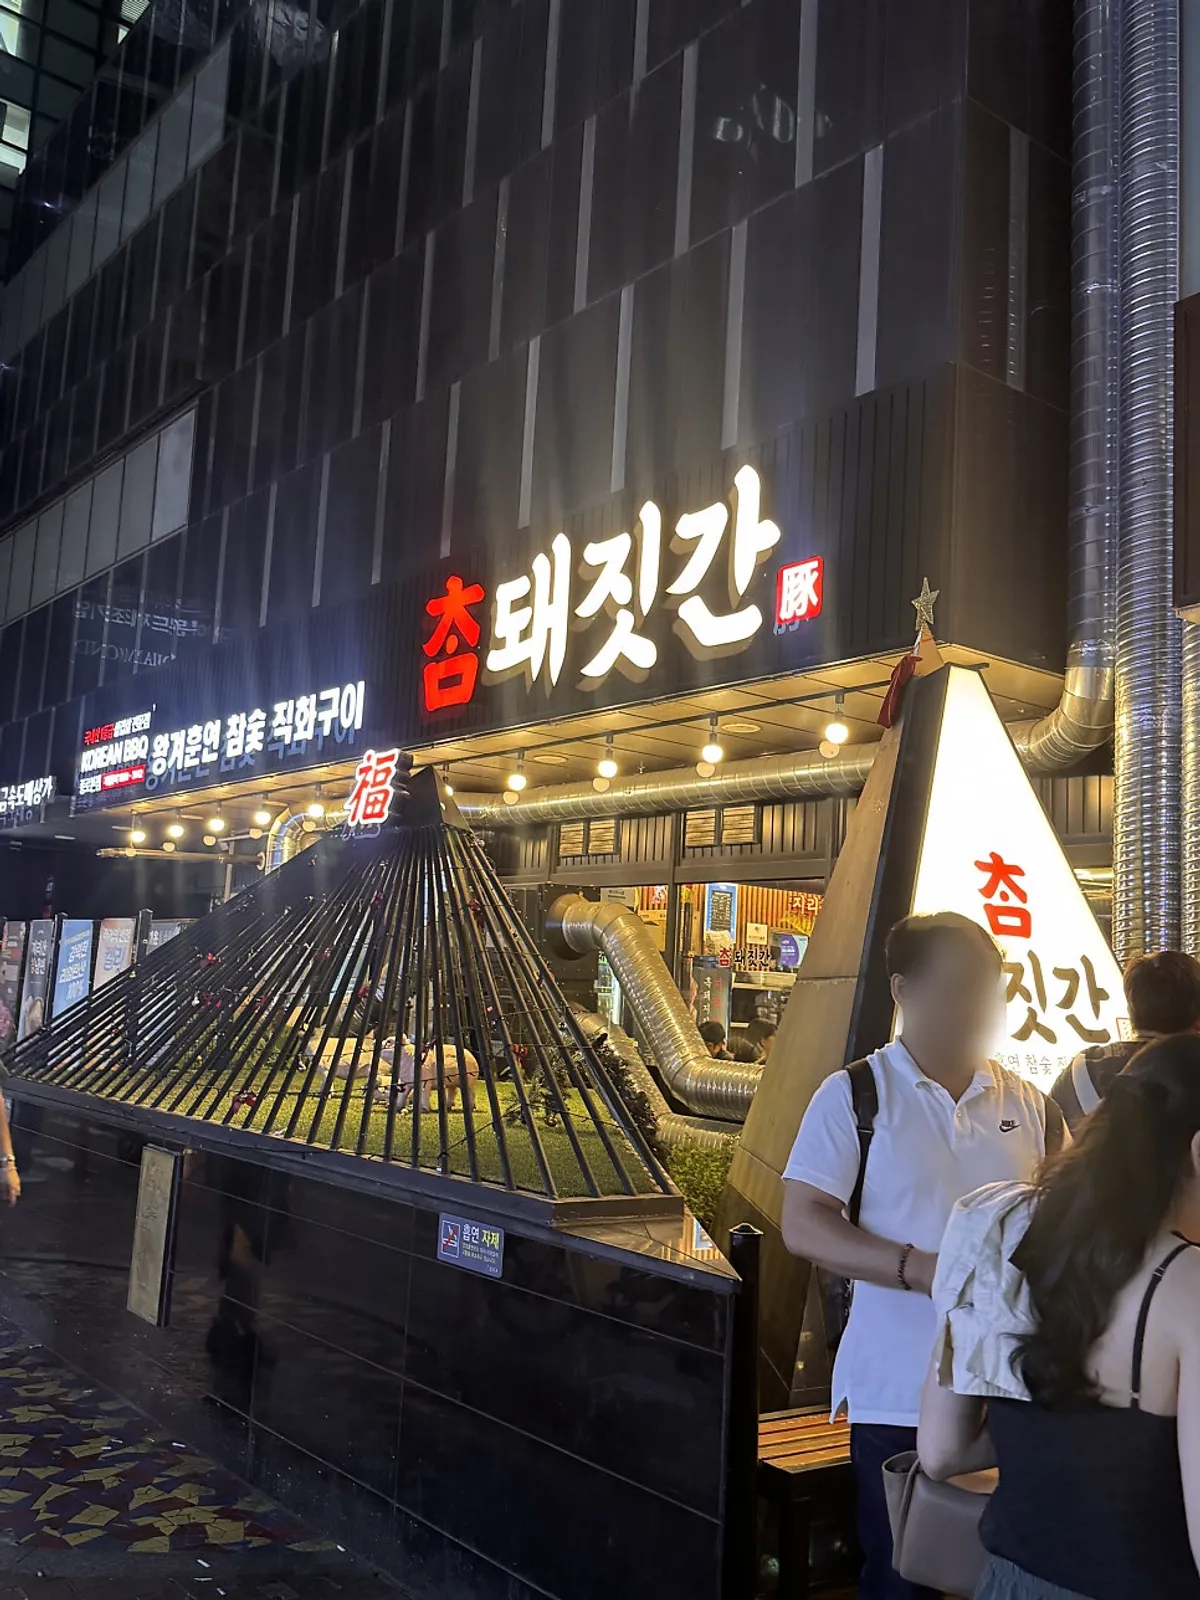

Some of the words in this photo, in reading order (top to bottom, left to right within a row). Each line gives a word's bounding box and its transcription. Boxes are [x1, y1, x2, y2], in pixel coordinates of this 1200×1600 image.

[778, 559, 821, 622] 豚
[81, 741, 123, 773] KOREAN
[124, 734, 149, 762] BBQ
[226, 708, 267, 758] 참숯
[272, 681, 365, 744] 직화구이
[345, 750, 398, 825] 福
[1003, 949, 1111, 1044] 짓간
[462, 1223, 479, 1243] 흡연
[482, 1229, 499, 1250] 자제
